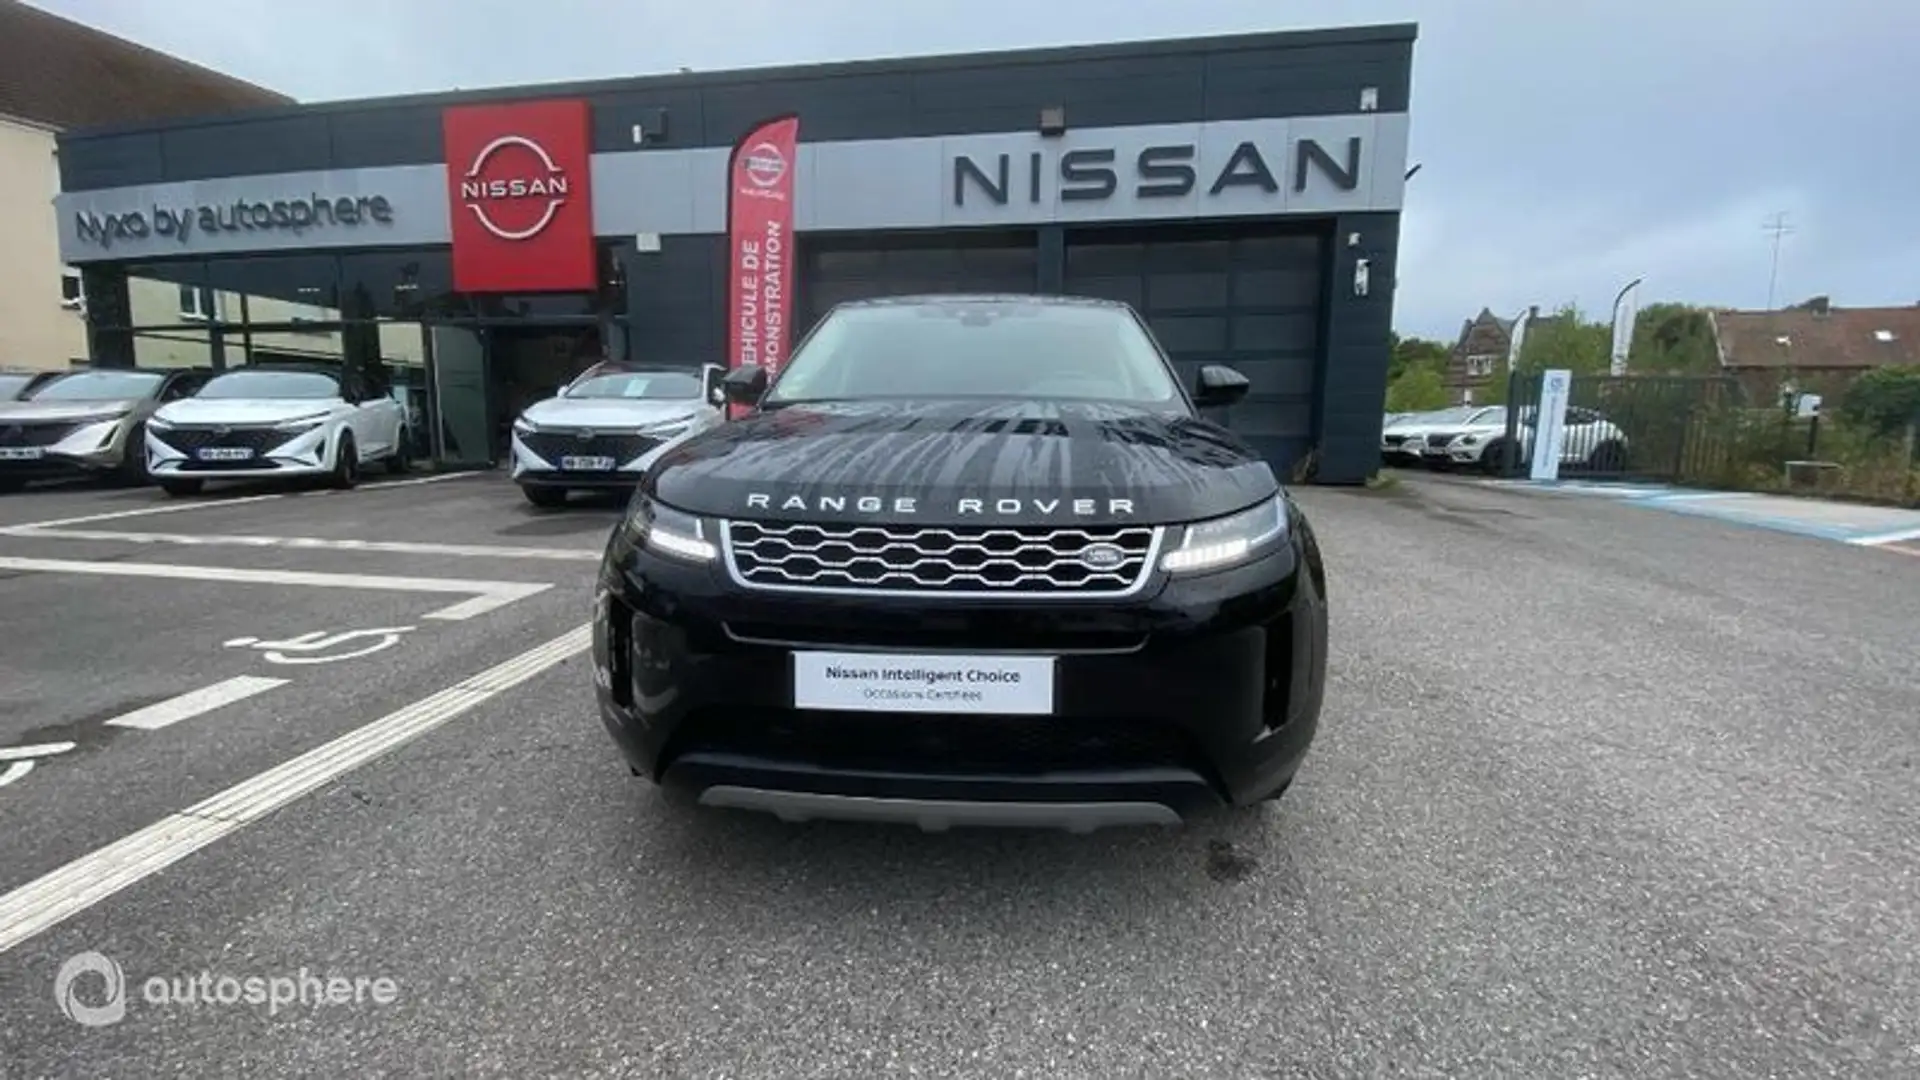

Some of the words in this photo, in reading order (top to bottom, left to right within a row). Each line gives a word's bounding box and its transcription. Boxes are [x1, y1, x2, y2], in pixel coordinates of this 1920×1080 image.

[953, 136, 1361, 206] NISSAN
[461, 177, 568, 198] NISSAN
[77, 209, 150, 249] Nyxo
[154, 203, 193, 243] by
[198, 192, 394, 235] autosphere
[742, 240, 760, 270] DE
[747, 493, 917, 514] RANGE
[957, 498, 1136, 516] ROVER
[825, 666, 879, 681] Nissan
[882, 669, 963, 685] Intelligent
[966, 669, 1021, 684] Choice
